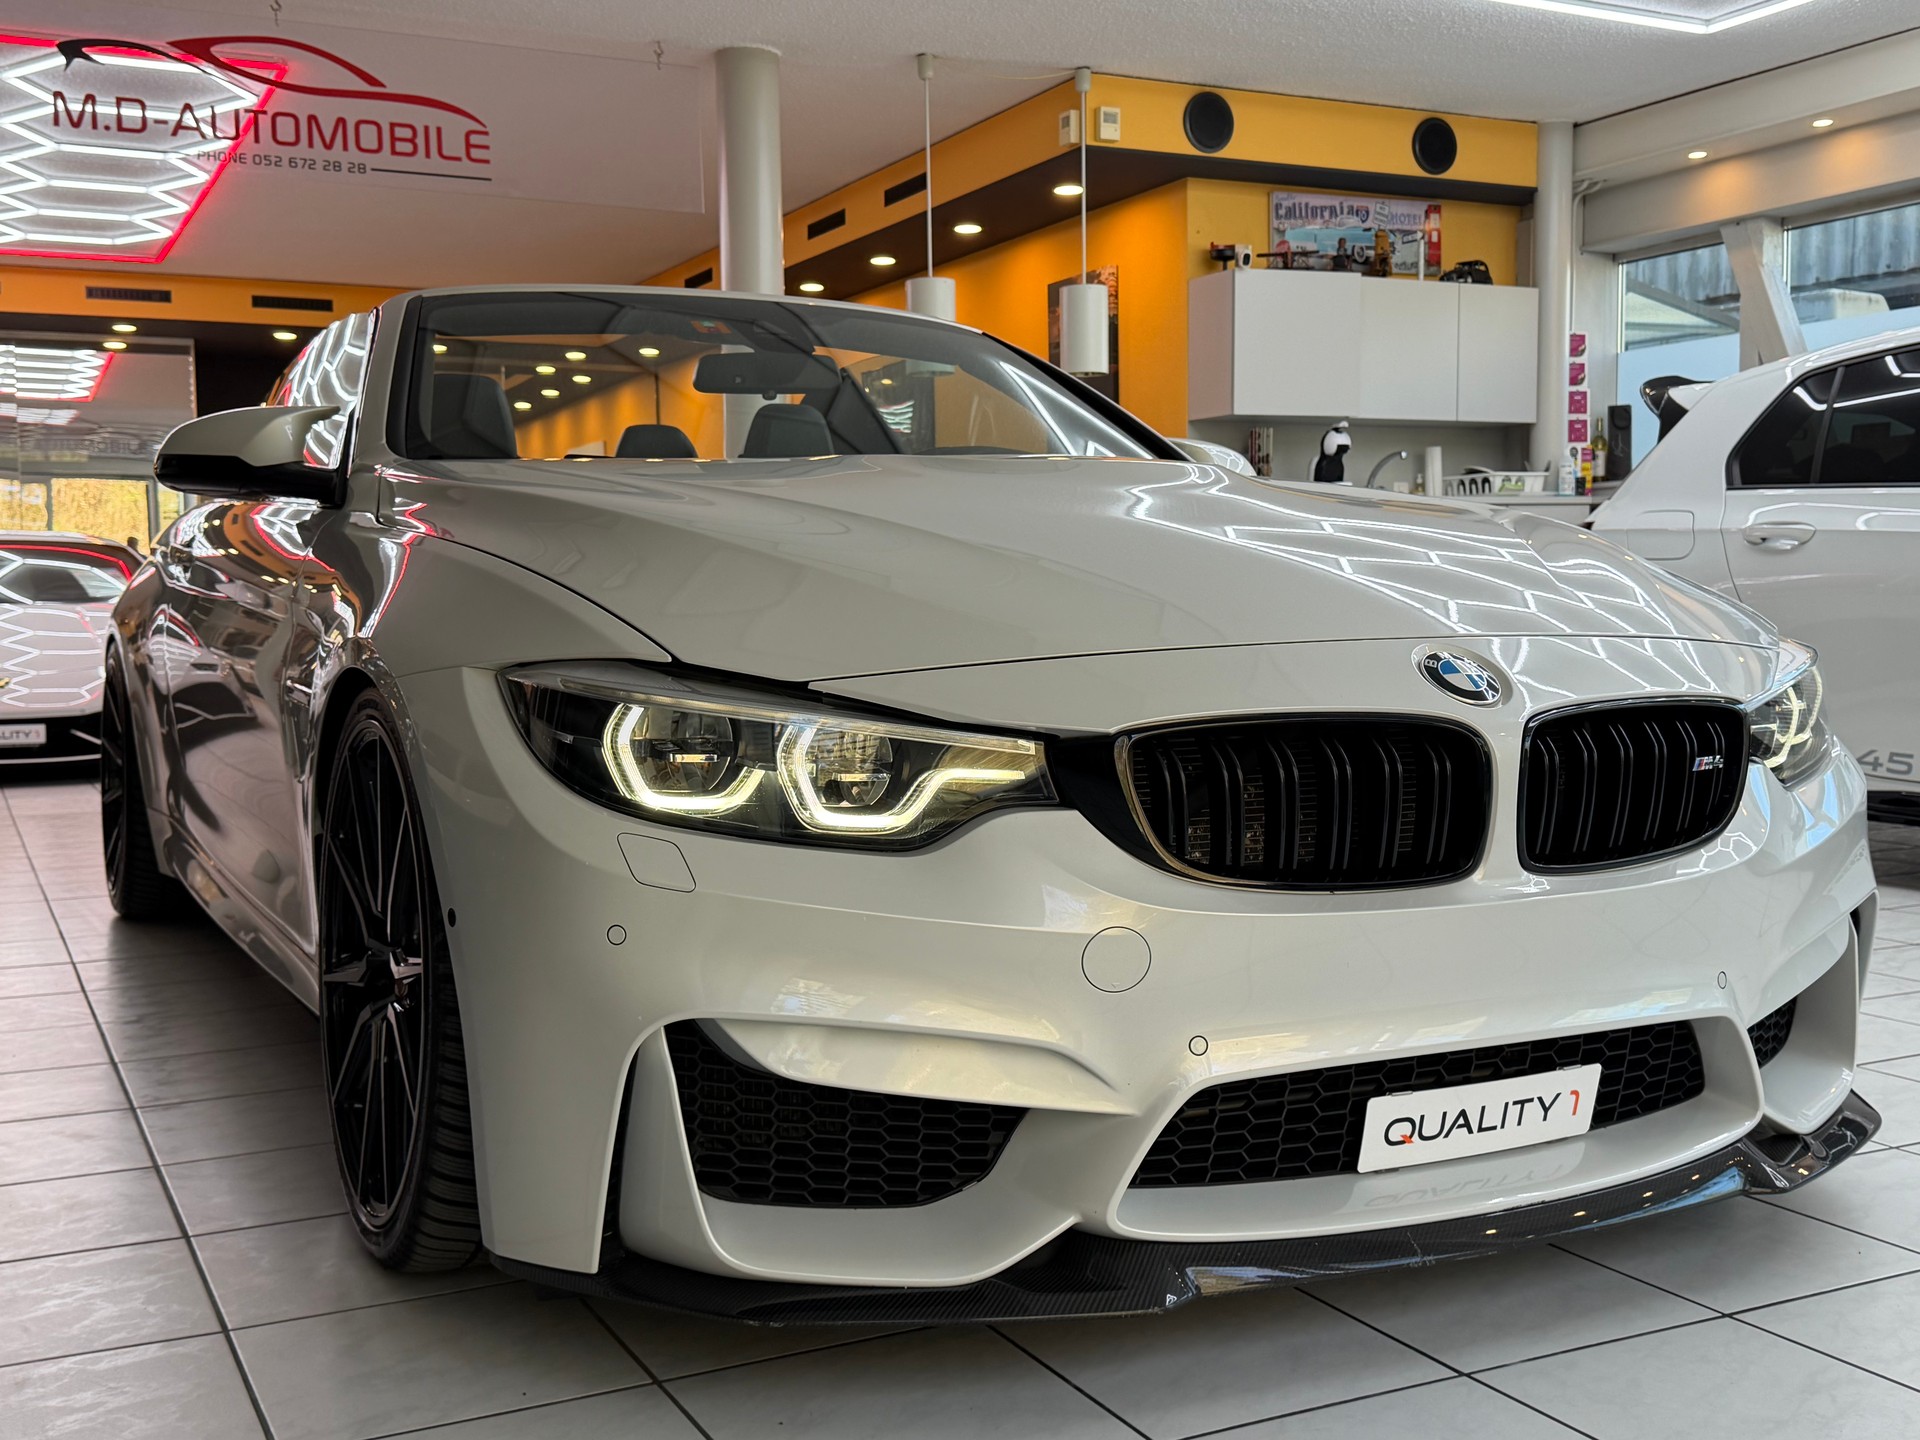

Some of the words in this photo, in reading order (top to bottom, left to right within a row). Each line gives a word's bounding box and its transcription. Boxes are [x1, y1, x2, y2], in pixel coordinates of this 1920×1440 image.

[52, 90, 491, 164] M.D-AUTOMOBILE
[196, 149, 248, 165] PHONE
[252, 153, 283, 167] 052
[288, 156, 317, 170] 672
[321, 159, 344, 172] 28
[346, 160, 367, 174] 28
[1274, 201, 1355, 221] California
[1856, 749, 1915, 775] 45
[1383, 1092, 1562, 1147] QUALITY
[1569, 1089, 1581, 1116] 1
